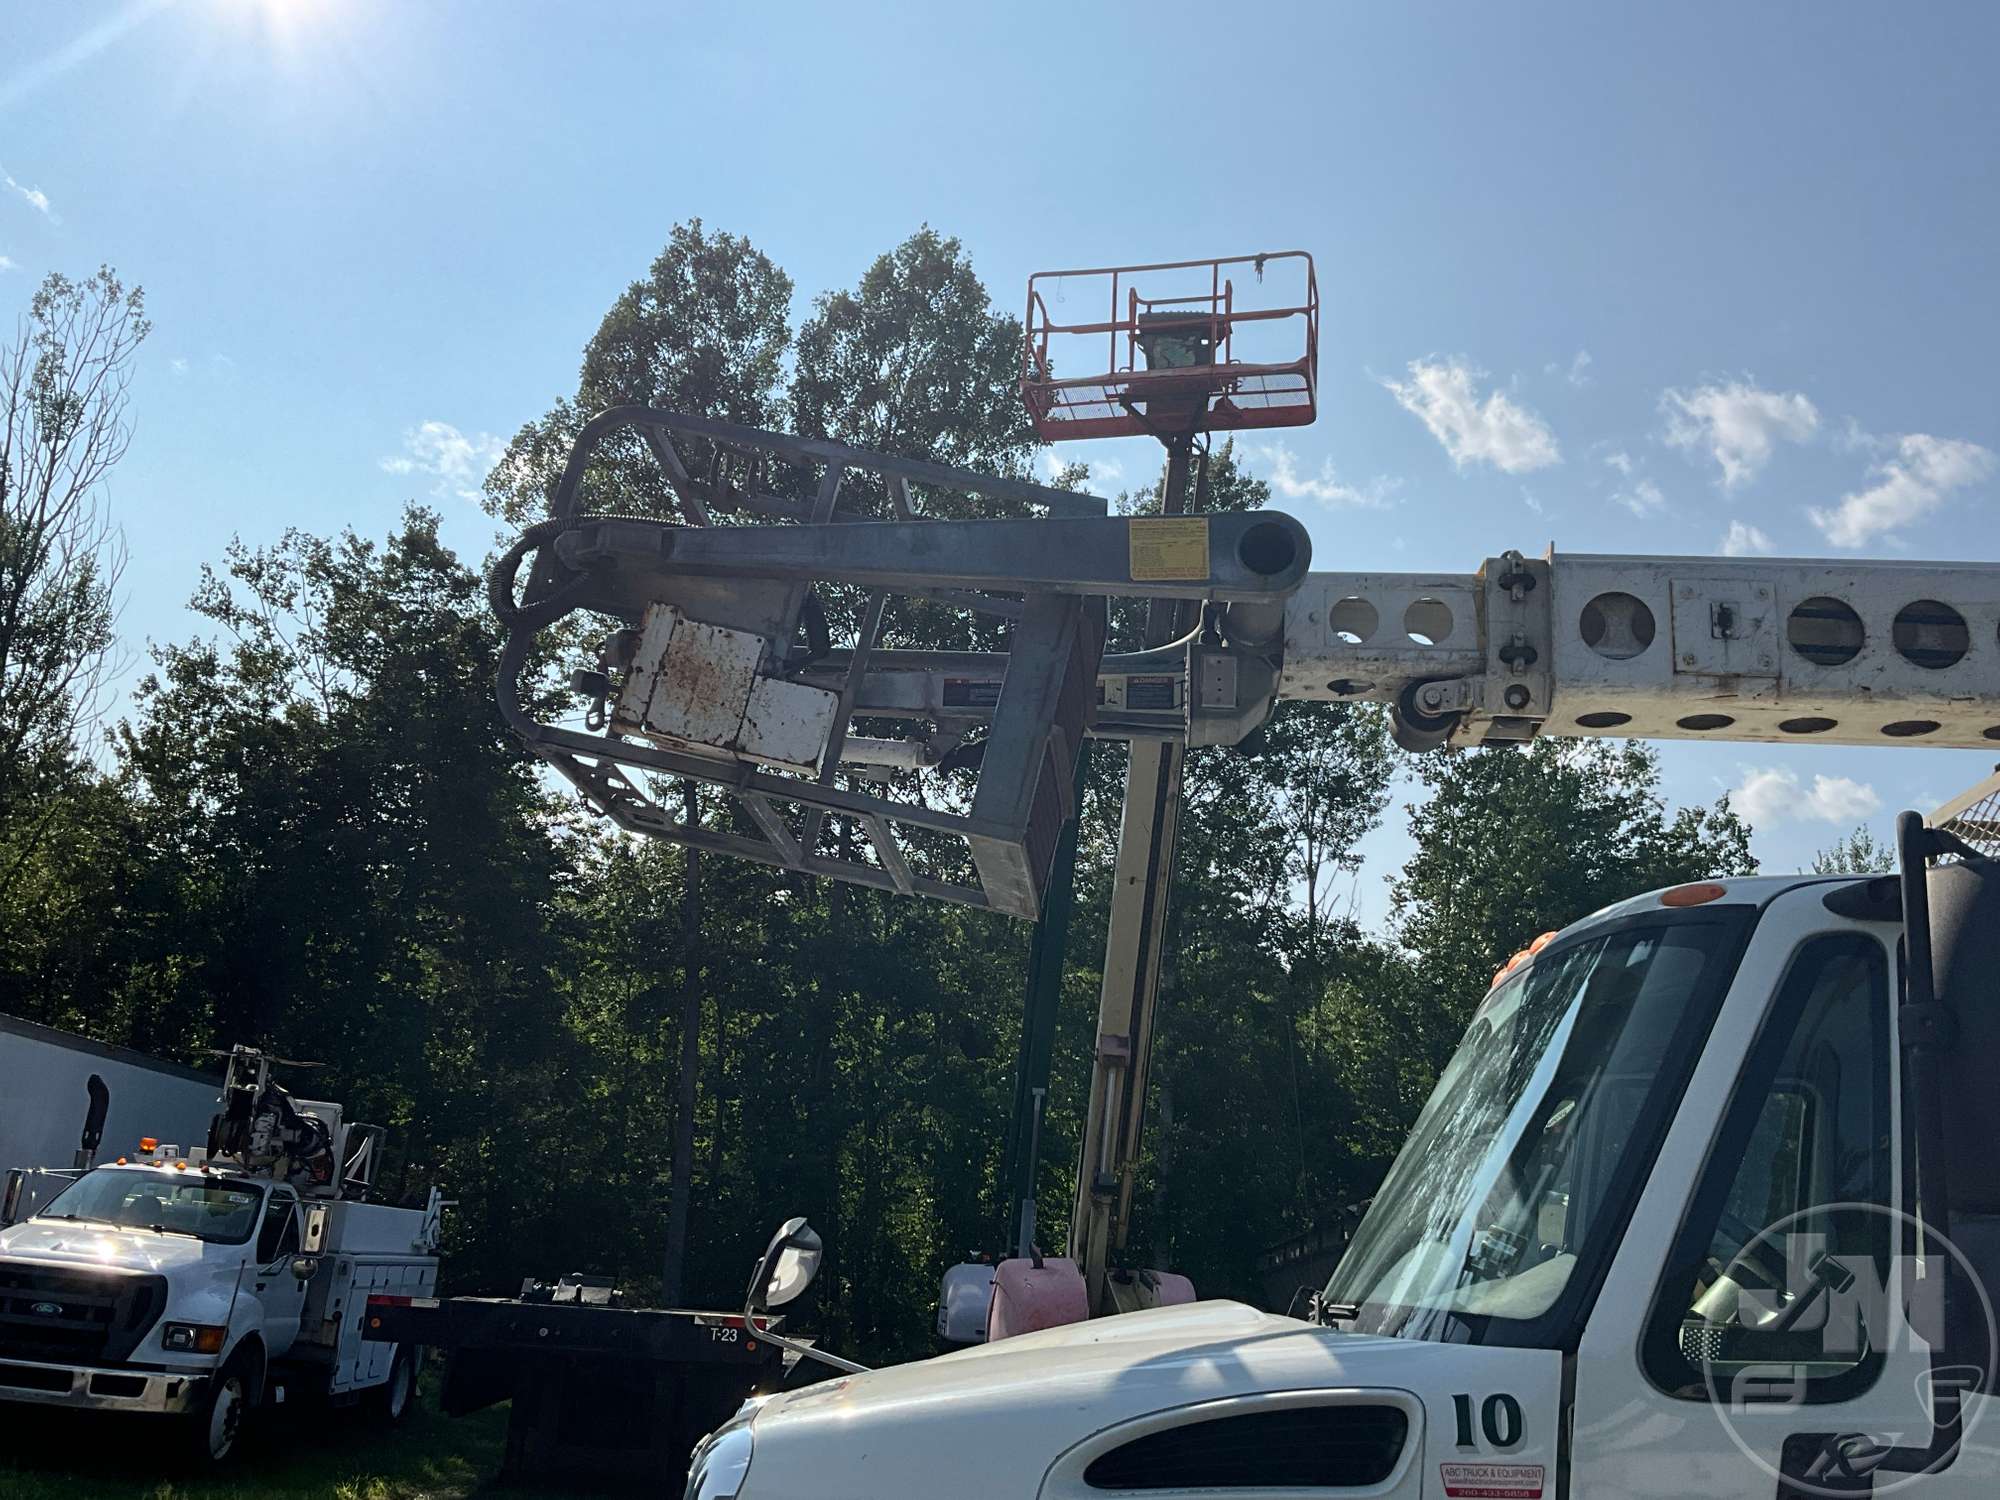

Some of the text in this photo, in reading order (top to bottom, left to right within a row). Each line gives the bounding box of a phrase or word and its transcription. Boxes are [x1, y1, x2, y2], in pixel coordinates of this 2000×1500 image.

[710, 1327, 738, 1342] T-23
[1451, 1392, 1526, 1453] 10
[1463, 1467, 1489, 1478] TRUCK
[1497, 1468, 1542, 1479] EQUIPMENT
